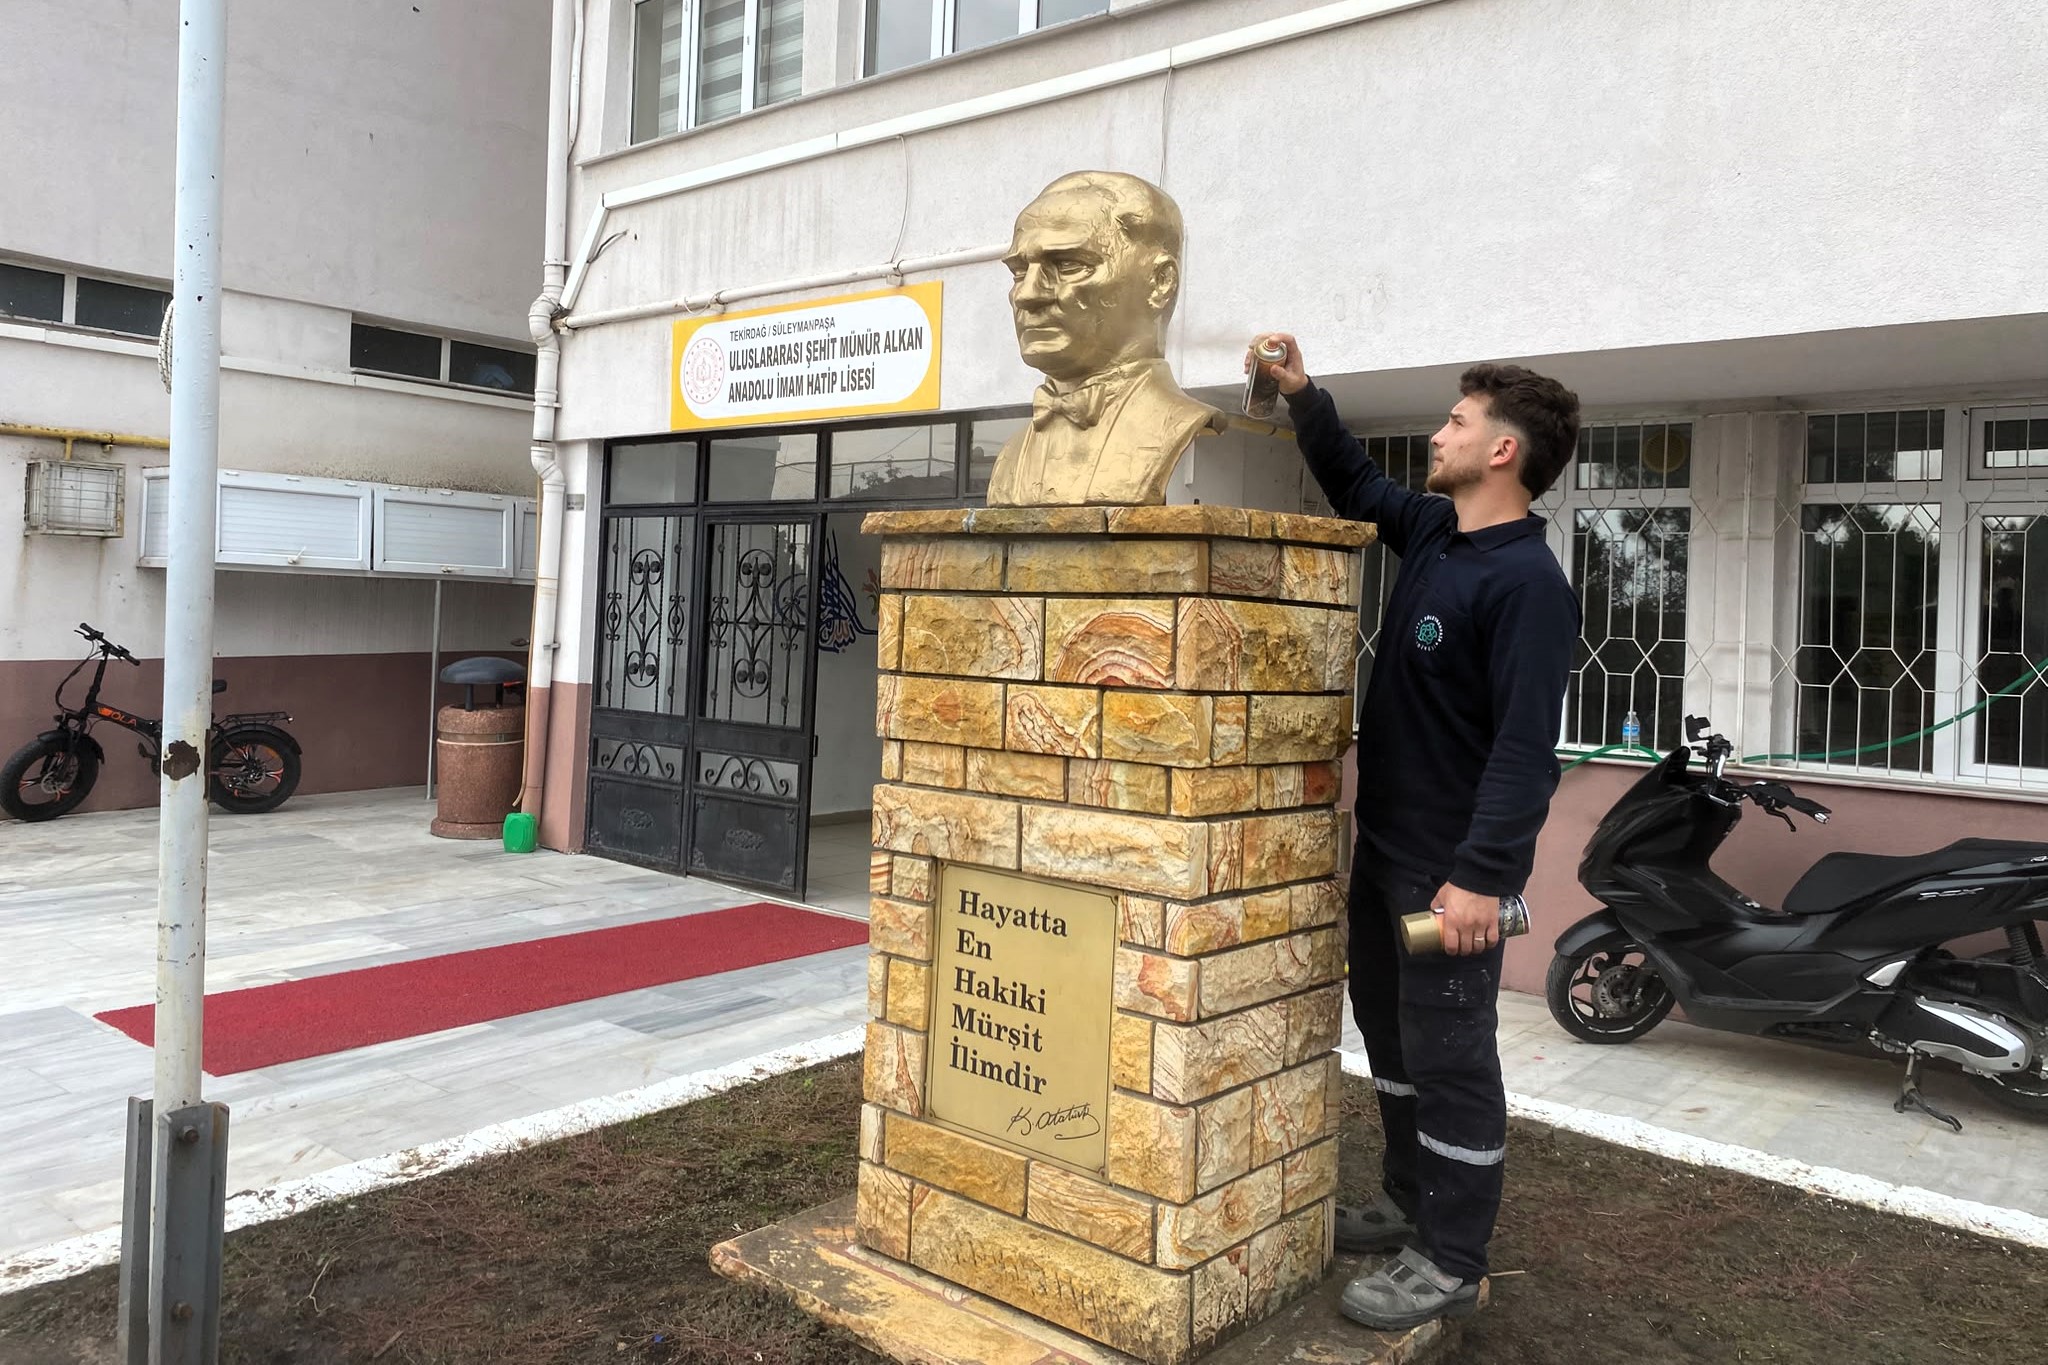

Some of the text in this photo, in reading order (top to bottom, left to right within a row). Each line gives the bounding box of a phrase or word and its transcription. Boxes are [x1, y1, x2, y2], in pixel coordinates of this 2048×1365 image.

[729, 342, 803, 372] ULUSLARARASI
[805, 332, 837, 369] ŞEHİT
[839, 327, 880, 358] MÜNÜR
[883, 326, 924, 354] ALKAN
[730, 323, 767, 342] TEKİRDAĞ
[772, 316, 836, 336] SÜLEYMANPAŞA
[728, 361, 875, 403] ANADOLU İMAM HATİP LİSESİ
[958, 889, 1068, 937] Hayatta
[955, 928, 993, 961] En
[953, 966, 1046, 1015] Hakiki
[951, 1003, 1043, 1053] Mürşit
[949, 1036, 1047, 1095] İlimdir
